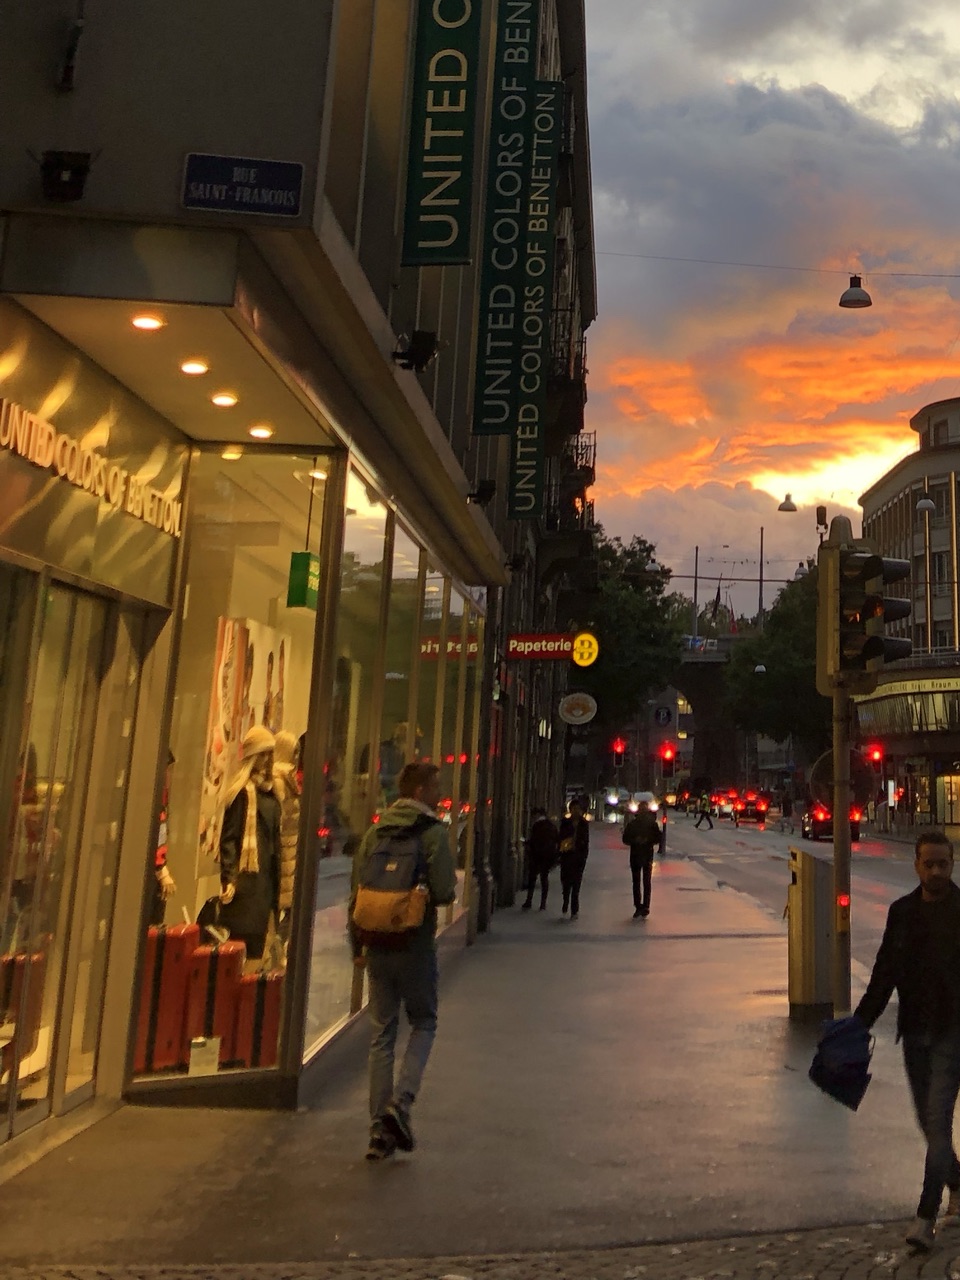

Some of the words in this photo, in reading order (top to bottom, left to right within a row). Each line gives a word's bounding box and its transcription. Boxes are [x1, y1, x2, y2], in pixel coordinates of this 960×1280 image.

[418, 48, 469, 249] UNITED
[501, 76, 527, 121] OF
[232, 166, 258, 183] RUE
[491, 132, 524, 270] COLORS
[528, 86, 557, 232] BENETTON.
[525, 246, 547, 277] OF
[482, 284, 516, 424] UNITED
[520, 285, 545, 393] COLORS
[0, 398, 56, 468] UNITED
[56, 434, 107, 497] COLORS
[108, 465, 128, 511] OF
[515, 404, 539, 512] UNITED
[509, 639, 571, 655] Papeterie
